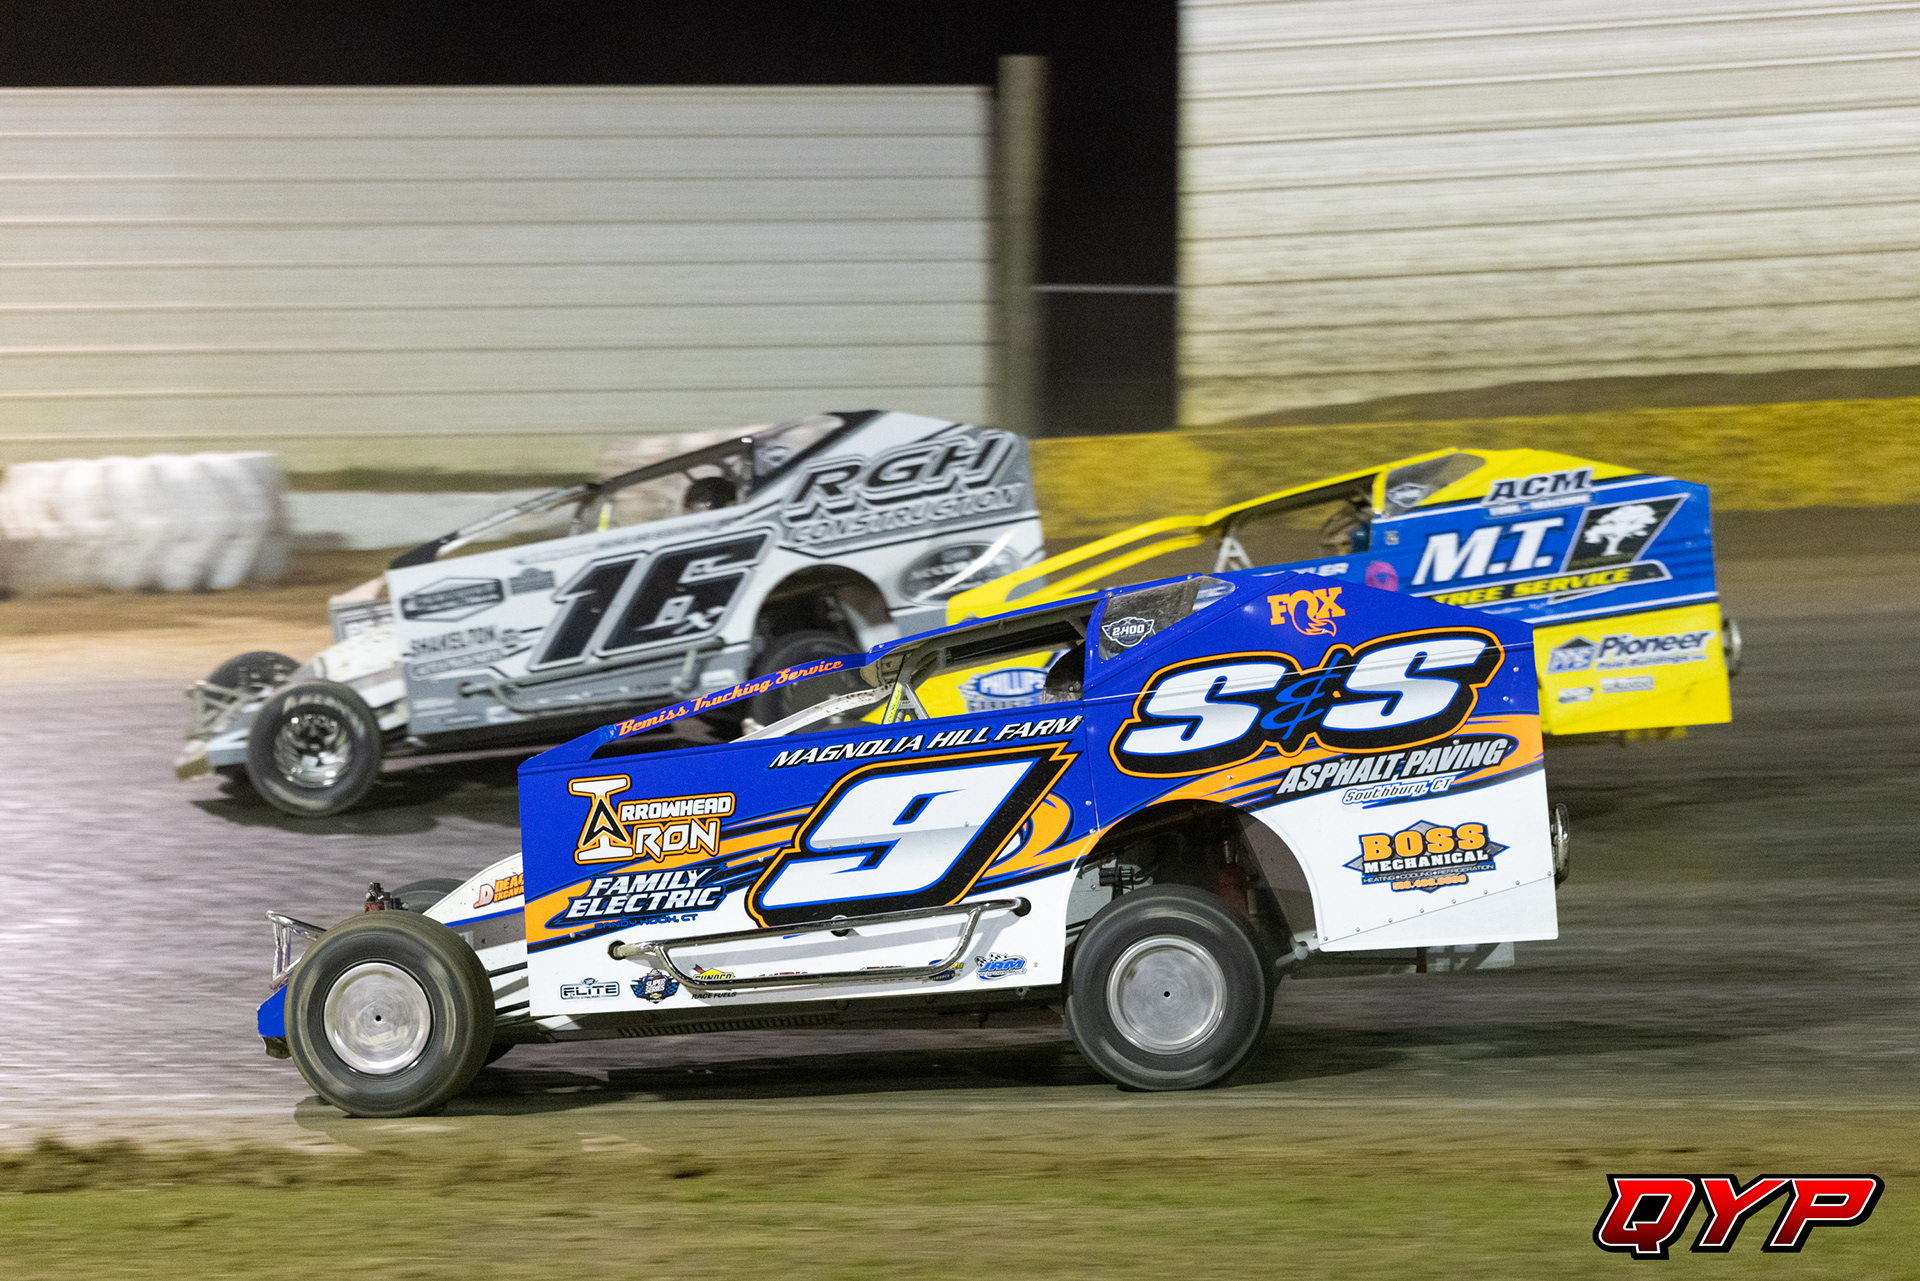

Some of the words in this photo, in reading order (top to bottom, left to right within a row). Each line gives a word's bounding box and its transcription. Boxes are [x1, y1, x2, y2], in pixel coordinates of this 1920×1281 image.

[788, 432, 1018, 522] RGH
[1488, 469, 1590, 501] ACM
[1411, 517, 1564, 585] M.T.
[1432, 586, 1504, 606] TREE
[1511, 568, 1632, 598] SERVICE
[1267, 586, 1345, 636] FOX
[1598, 631, 1710, 658] Pioneer
[615, 704, 691, 737] Bemiss
[690, 677, 774, 714] Trucking
[774, 659, 844, 685] Service
[980, 670, 1045, 695] PHILLIPS
[1120, 638, 1490, 755] S&S
[767, 733, 926, 769] MAGNOLIA
[926, 725, 990, 750] HILL
[993, 714, 1085, 742] FARM
[1276, 752, 1406, 795] ASPHALT
[1401, 738, 1509, 777] PAVING
[1345, 780, 1429, 803] Southbury,
[1431, 777, 1452, 792] CT
[761, 759, 1036, 912] 9
[1361, 823, 1487, 862] BOSS
[1364, 849, 1489, 874] MECHANICAL
[587, 866, 712, 897] FAMILY
[564, 886, 722, 920] ELECTRIC
[595, 918, 636, 930] SANDY
[640, 915, 679, 926] HOOK,
[681, 913, 698, 922] CT
[978, 959, 1024, 971] JAM
[563, 985, 618, 996] ELITE
[714, 991, 737, 999] FUELS
